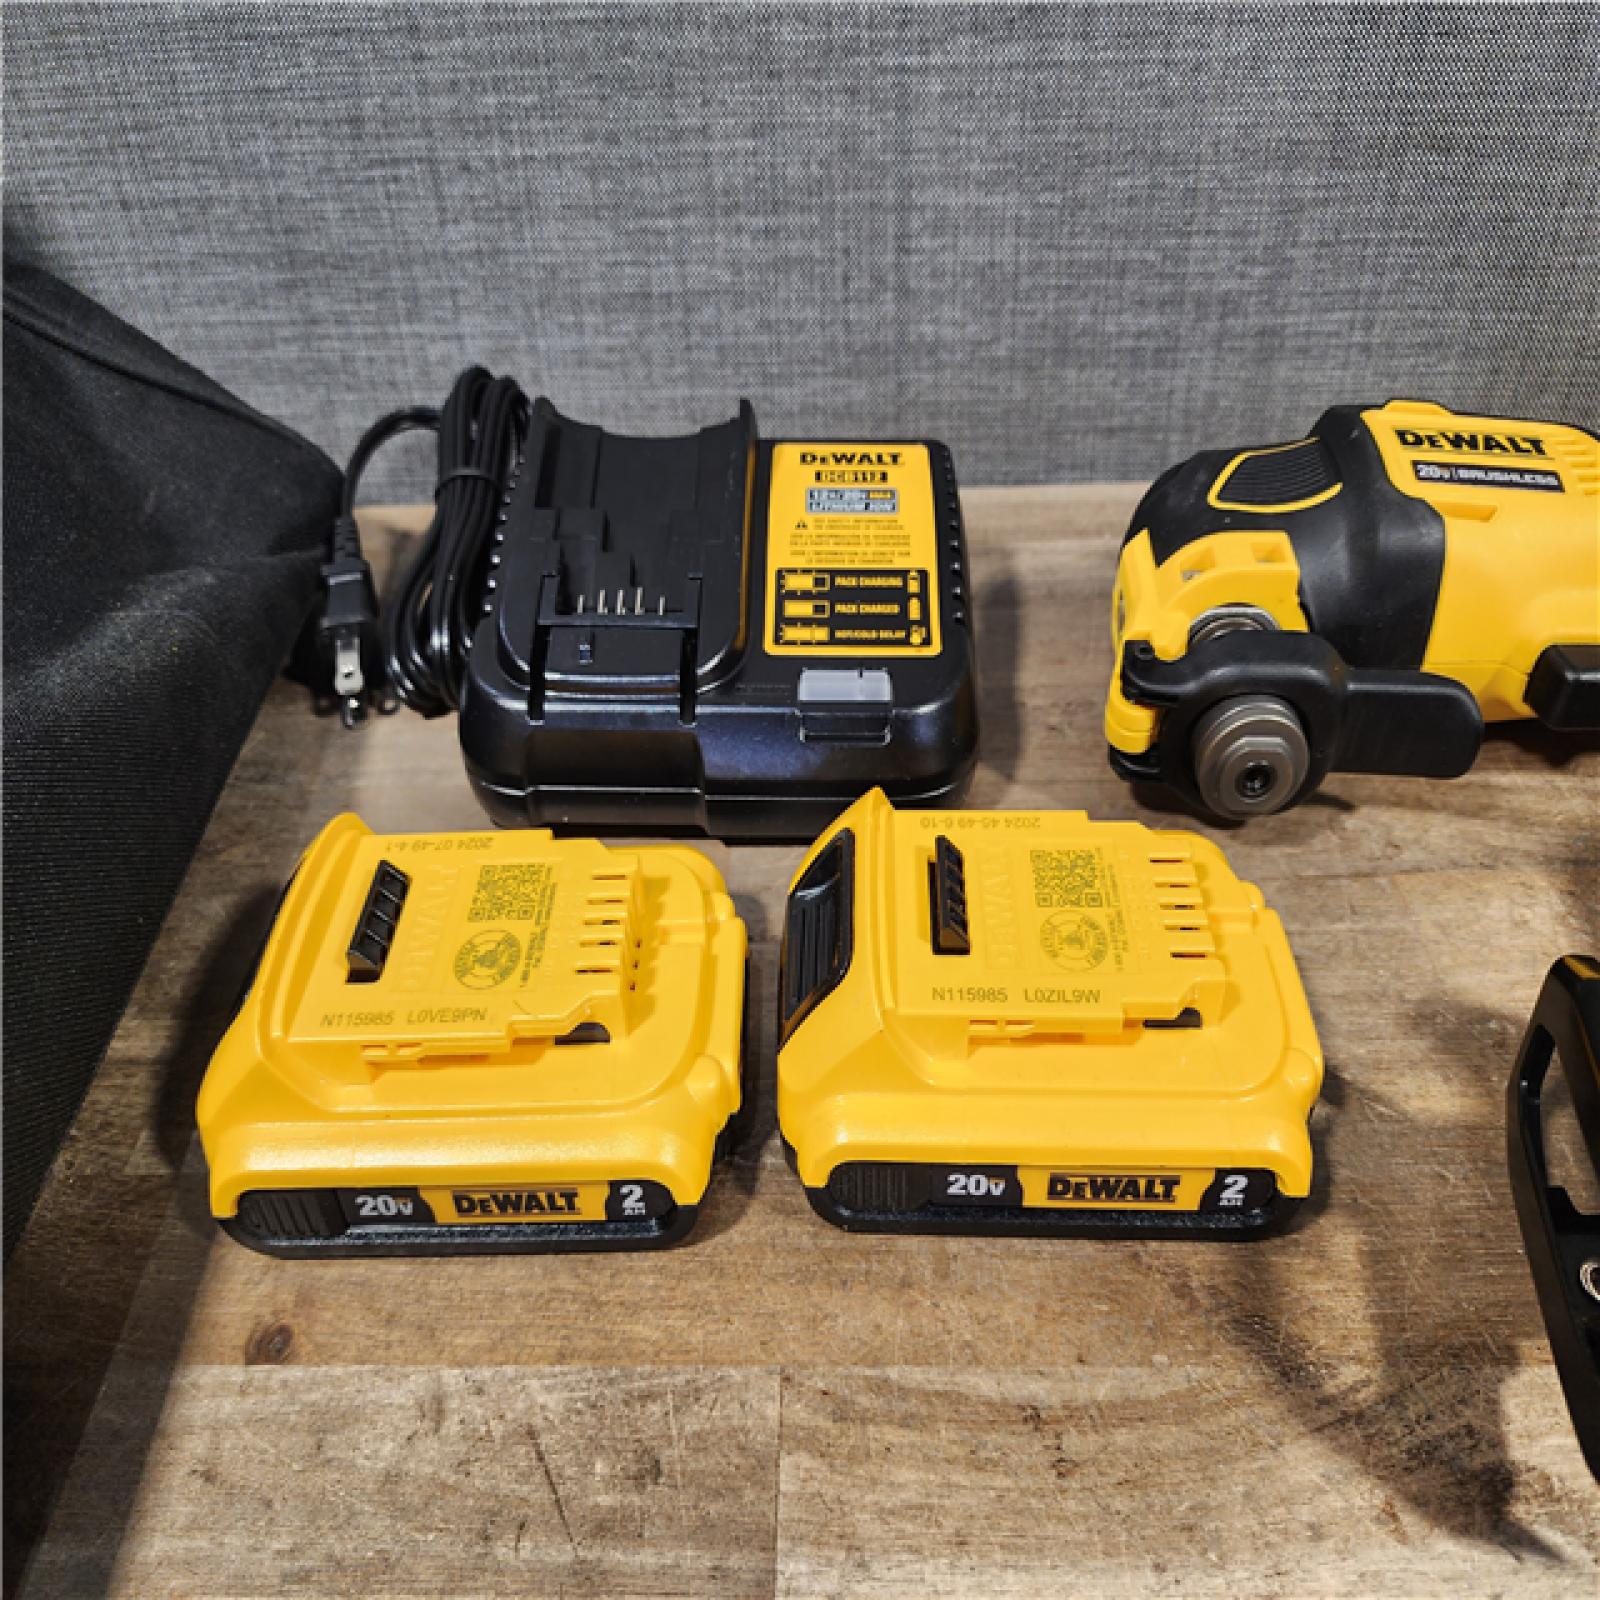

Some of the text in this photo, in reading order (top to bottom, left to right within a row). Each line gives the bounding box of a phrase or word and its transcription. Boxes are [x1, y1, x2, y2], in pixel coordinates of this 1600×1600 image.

[1395, 429, 1547, 455] DEWALT
[800, 452, 904, 466] DEWALT
[932, 986, 1008, 1003] N115985
[453, 1189, 582, 1217] DEWALT
[620, 1184, 644, 1208] 2
[1047, 1173, 1181, 1203] DEWALT
[1223, 1174, 1248, 1199] 2
